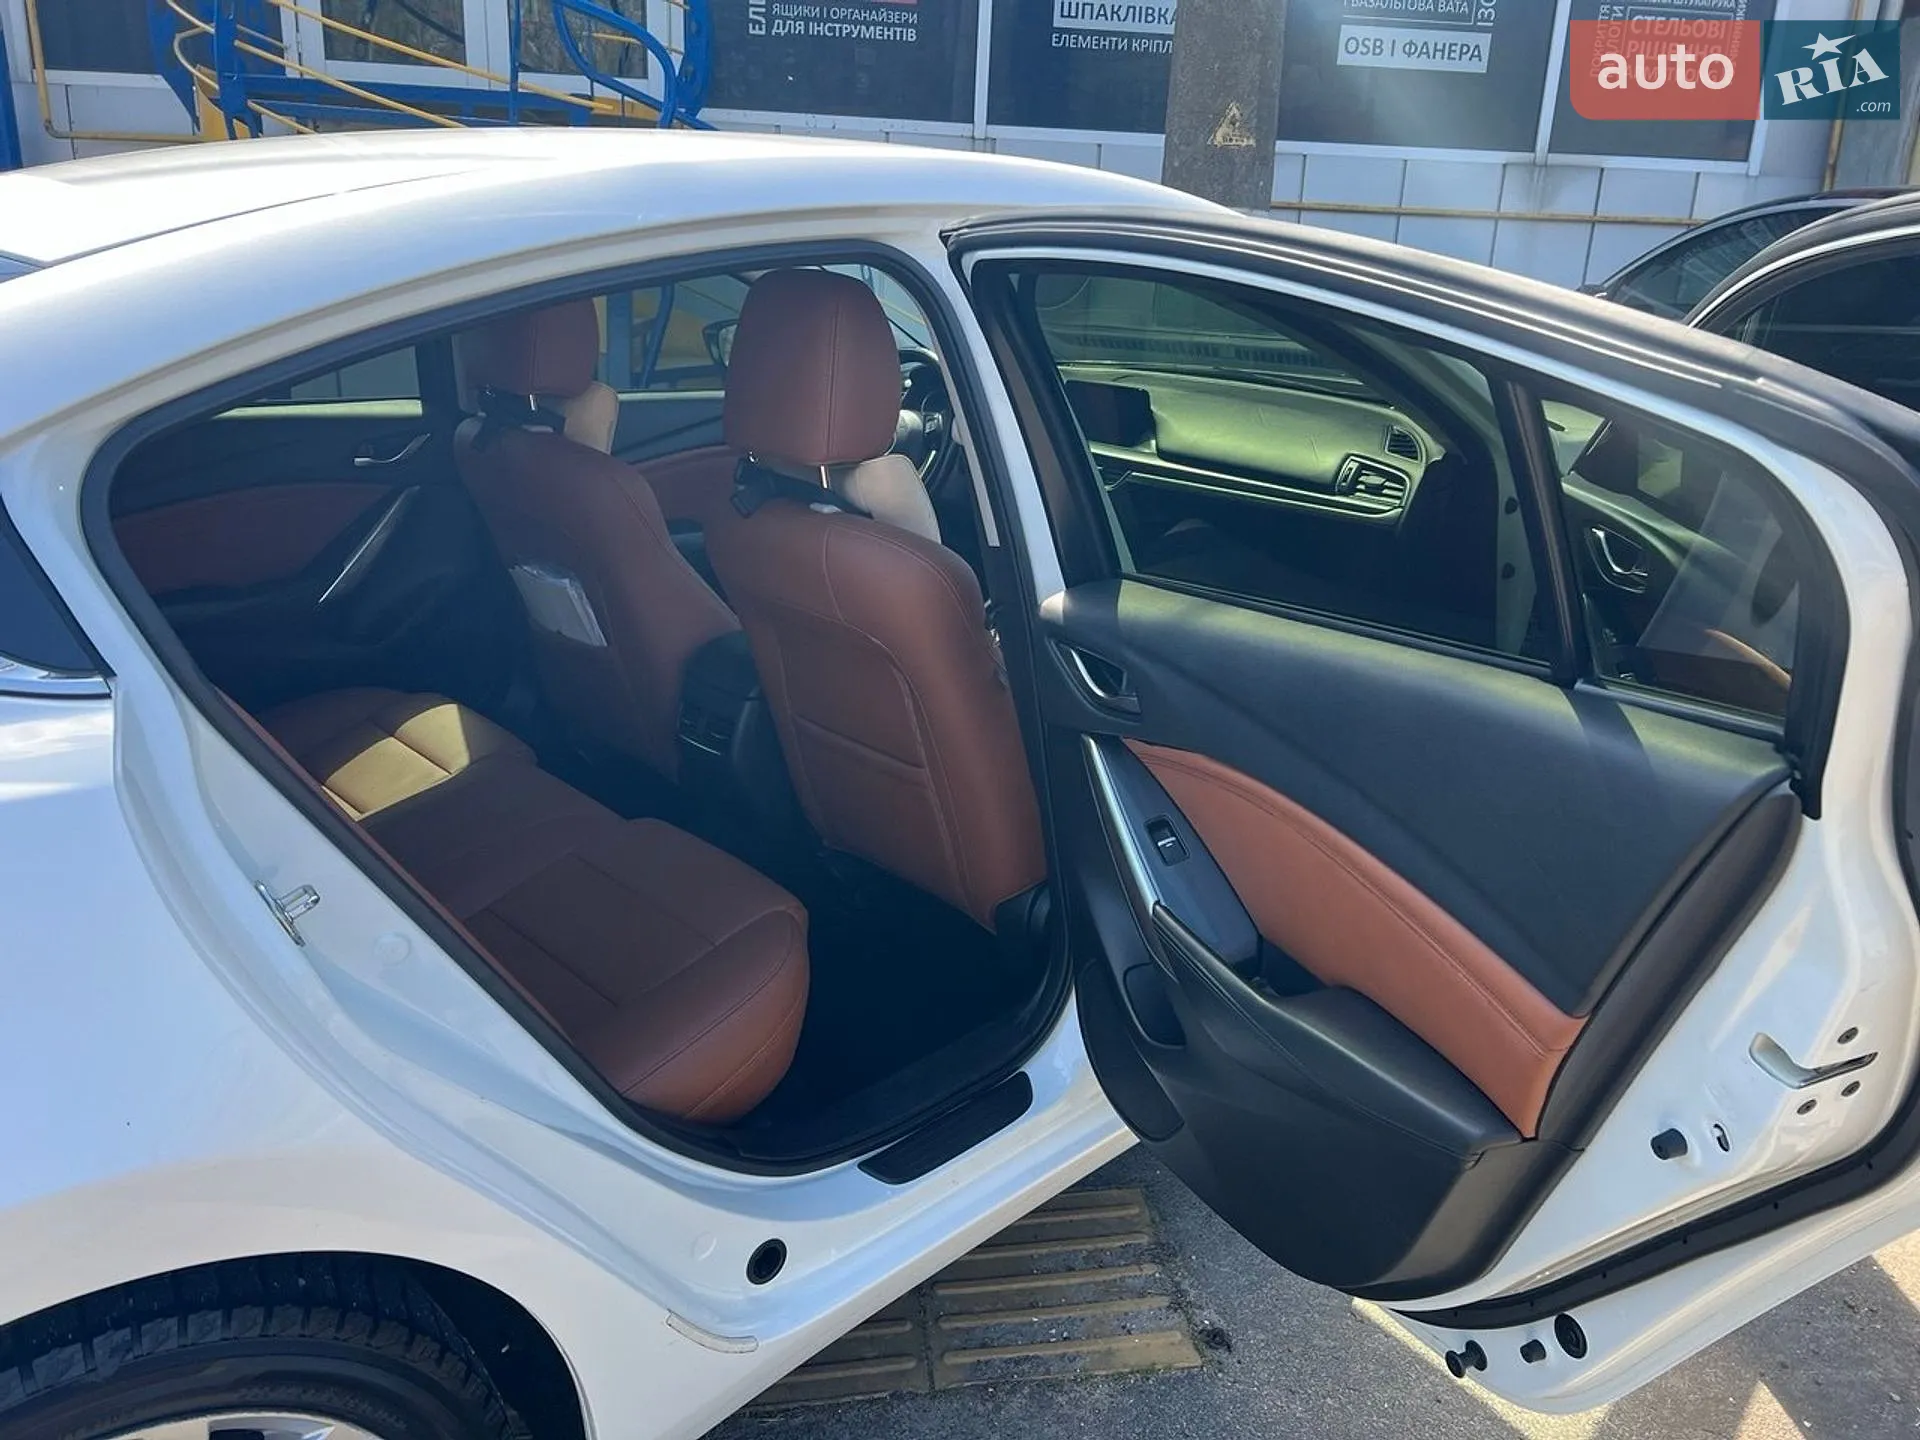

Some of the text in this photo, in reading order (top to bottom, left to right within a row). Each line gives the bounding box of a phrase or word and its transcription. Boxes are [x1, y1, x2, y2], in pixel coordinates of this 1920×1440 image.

[772, 3, 820, 18] ЯЩИКИ
[830, 7, 918, 24] ОРГАНАЙЗЕРИ
[1437, 0, 1470, 14] ВАТА
[771, 19, 917, 42] ДЛЯ ІНСТРУМЕНТІВ
[1629, 15, 1727, 39] СТЕЛЬОВІ
[1052, 33, 1128, 50] ЕЛЕМЕНТИ
[1345, 36, 1384, 57] OSB
[1402, 39, 1482, 62] ФАНЕРА
